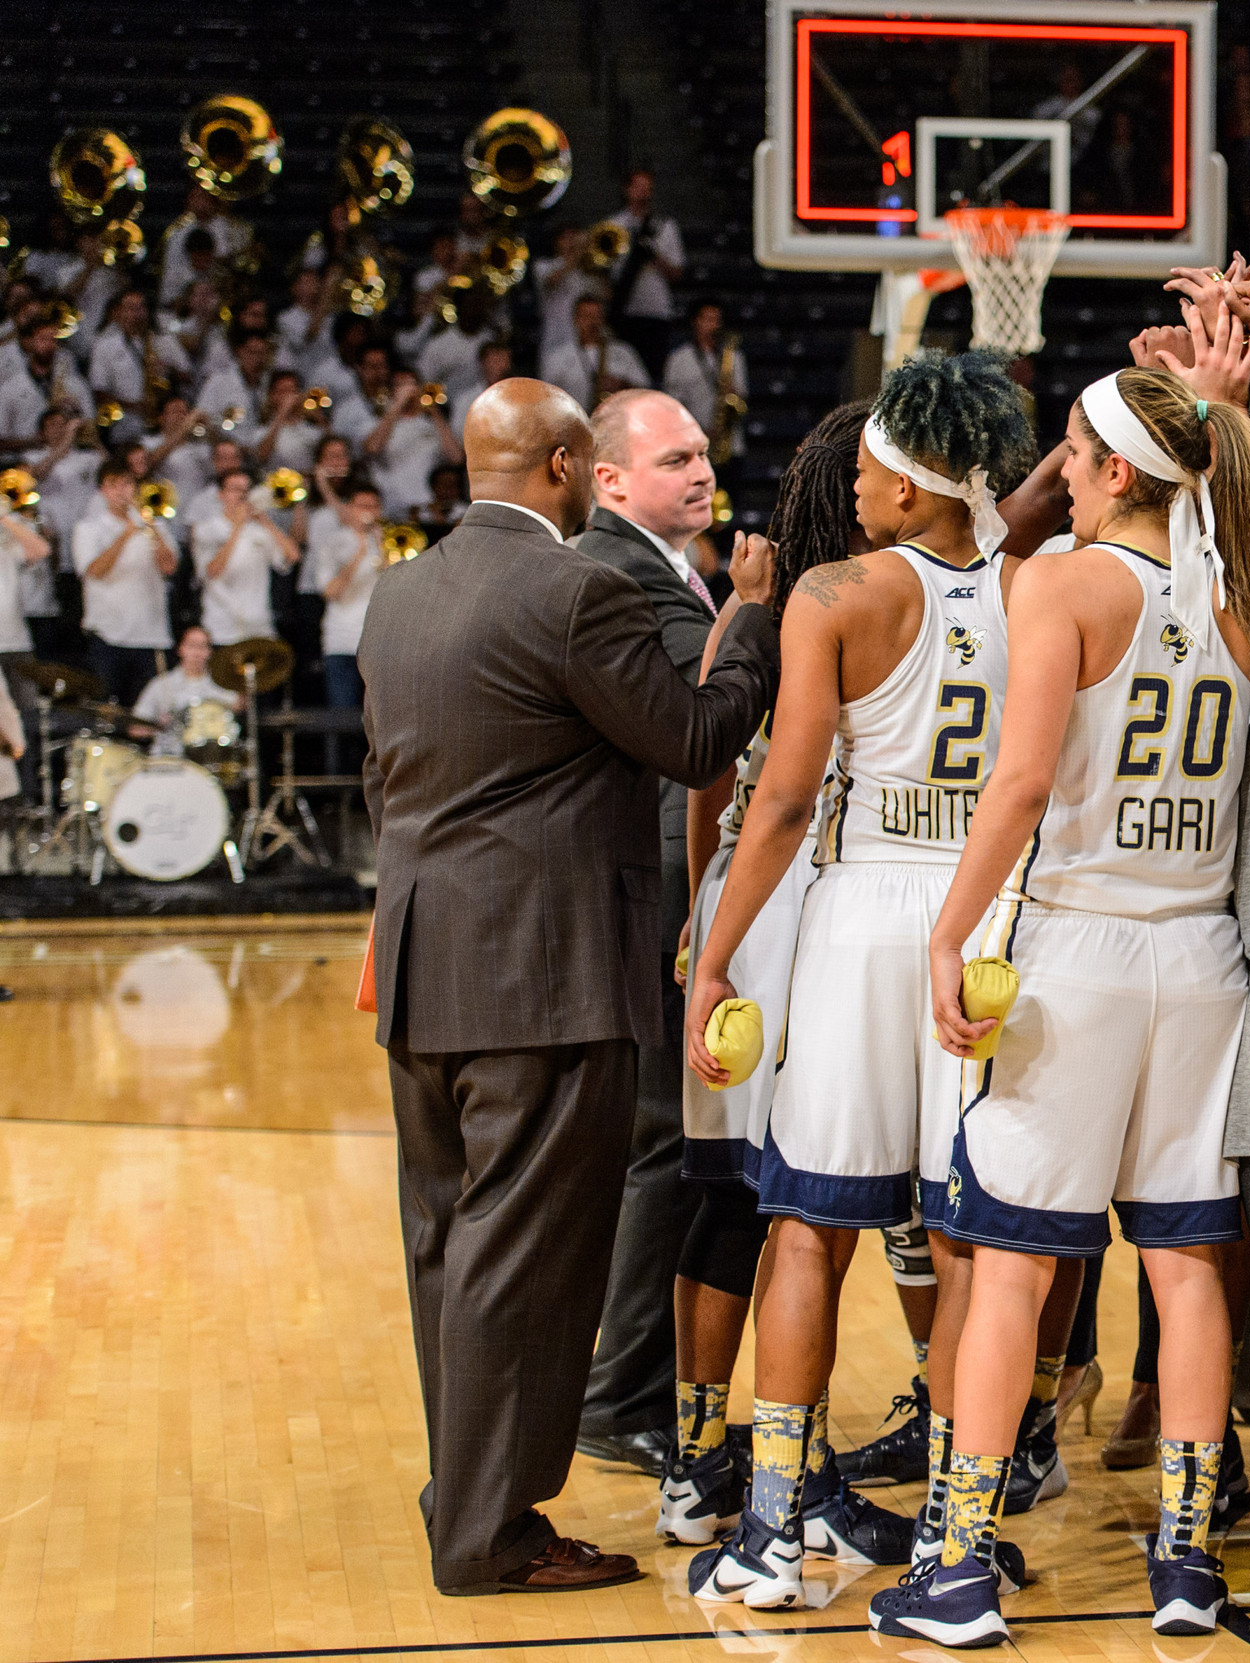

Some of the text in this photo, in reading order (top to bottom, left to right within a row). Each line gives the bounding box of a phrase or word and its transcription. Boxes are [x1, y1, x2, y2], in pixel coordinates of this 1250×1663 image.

[944, 586, 976, 599] ACC
[924, 679, 993, 785] 2
[1113, 672, 1238, 782] 20
[1116, 796, 1216, 854] GARI
